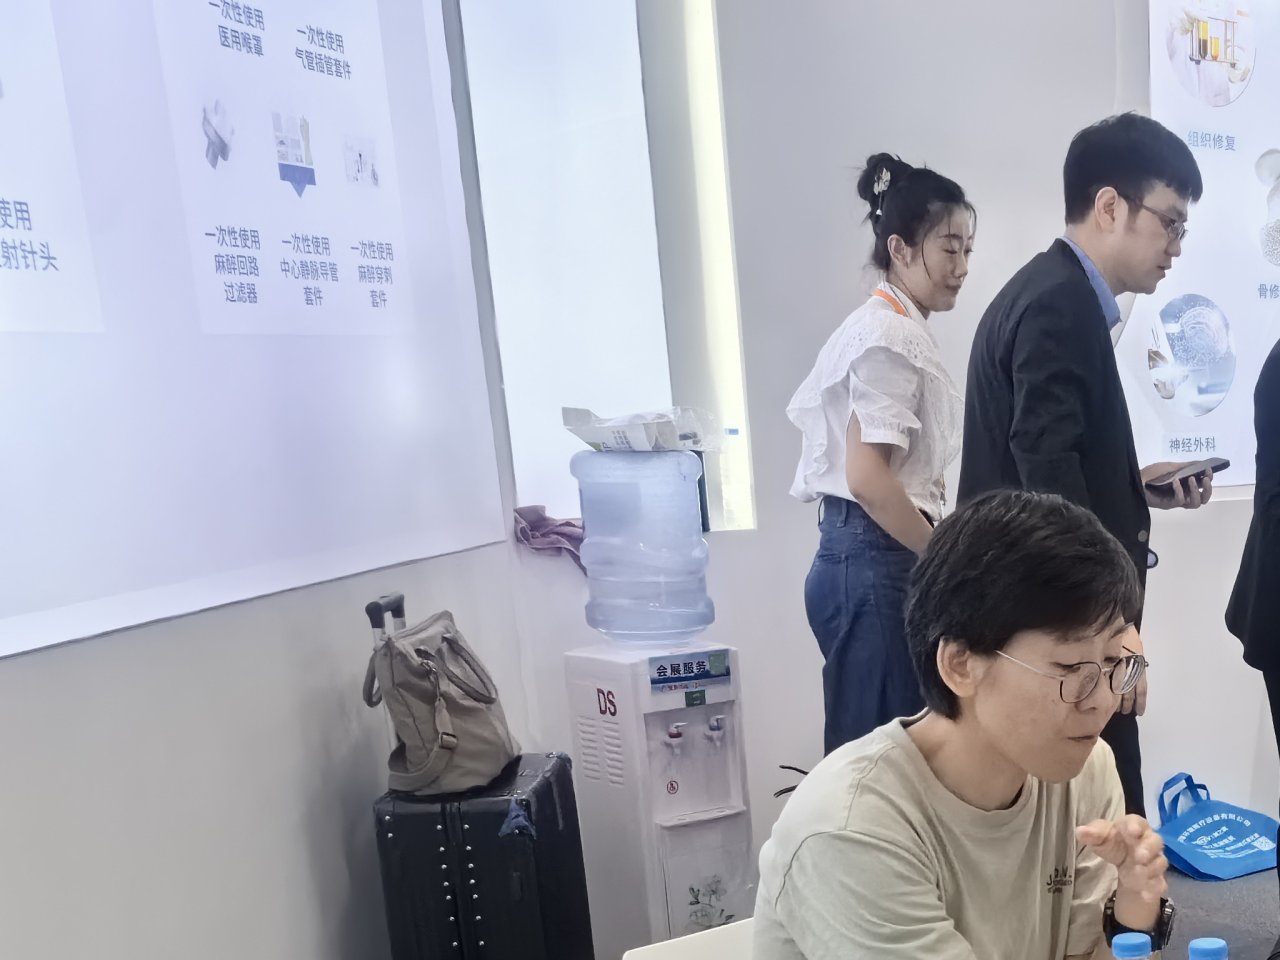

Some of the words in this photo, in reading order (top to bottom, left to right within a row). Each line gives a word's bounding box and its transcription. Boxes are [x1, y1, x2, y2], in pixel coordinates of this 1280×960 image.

[209, 0, 265, 31] 一次性使用
[218, 25, 264, 57] 医用喉罩
[296, 24, 344, 54] 一次性使用
[295, 47, 351, 80] 气管插管套件
[1187, 130, 1236, 151] 组织修复
[205, 225, 261, 251] 一次性使用
[282, 233, 331, 257] 一次性使用
[350, 240, 394, 262] 一次性使用
[214, 253, 259, 277] 麻醉回路
[280, 257, 338, 282] 中心静脉导管
[224, 281, 258, 304] 过滤器
[303, 286, 323, 306] 套件
[369, 289, 387, 309] 套件
[1169, 436, 1216, 453] 神经外科
[656, 660, 707, 677] 会展服务
[597, 688, 617, 716] DS
